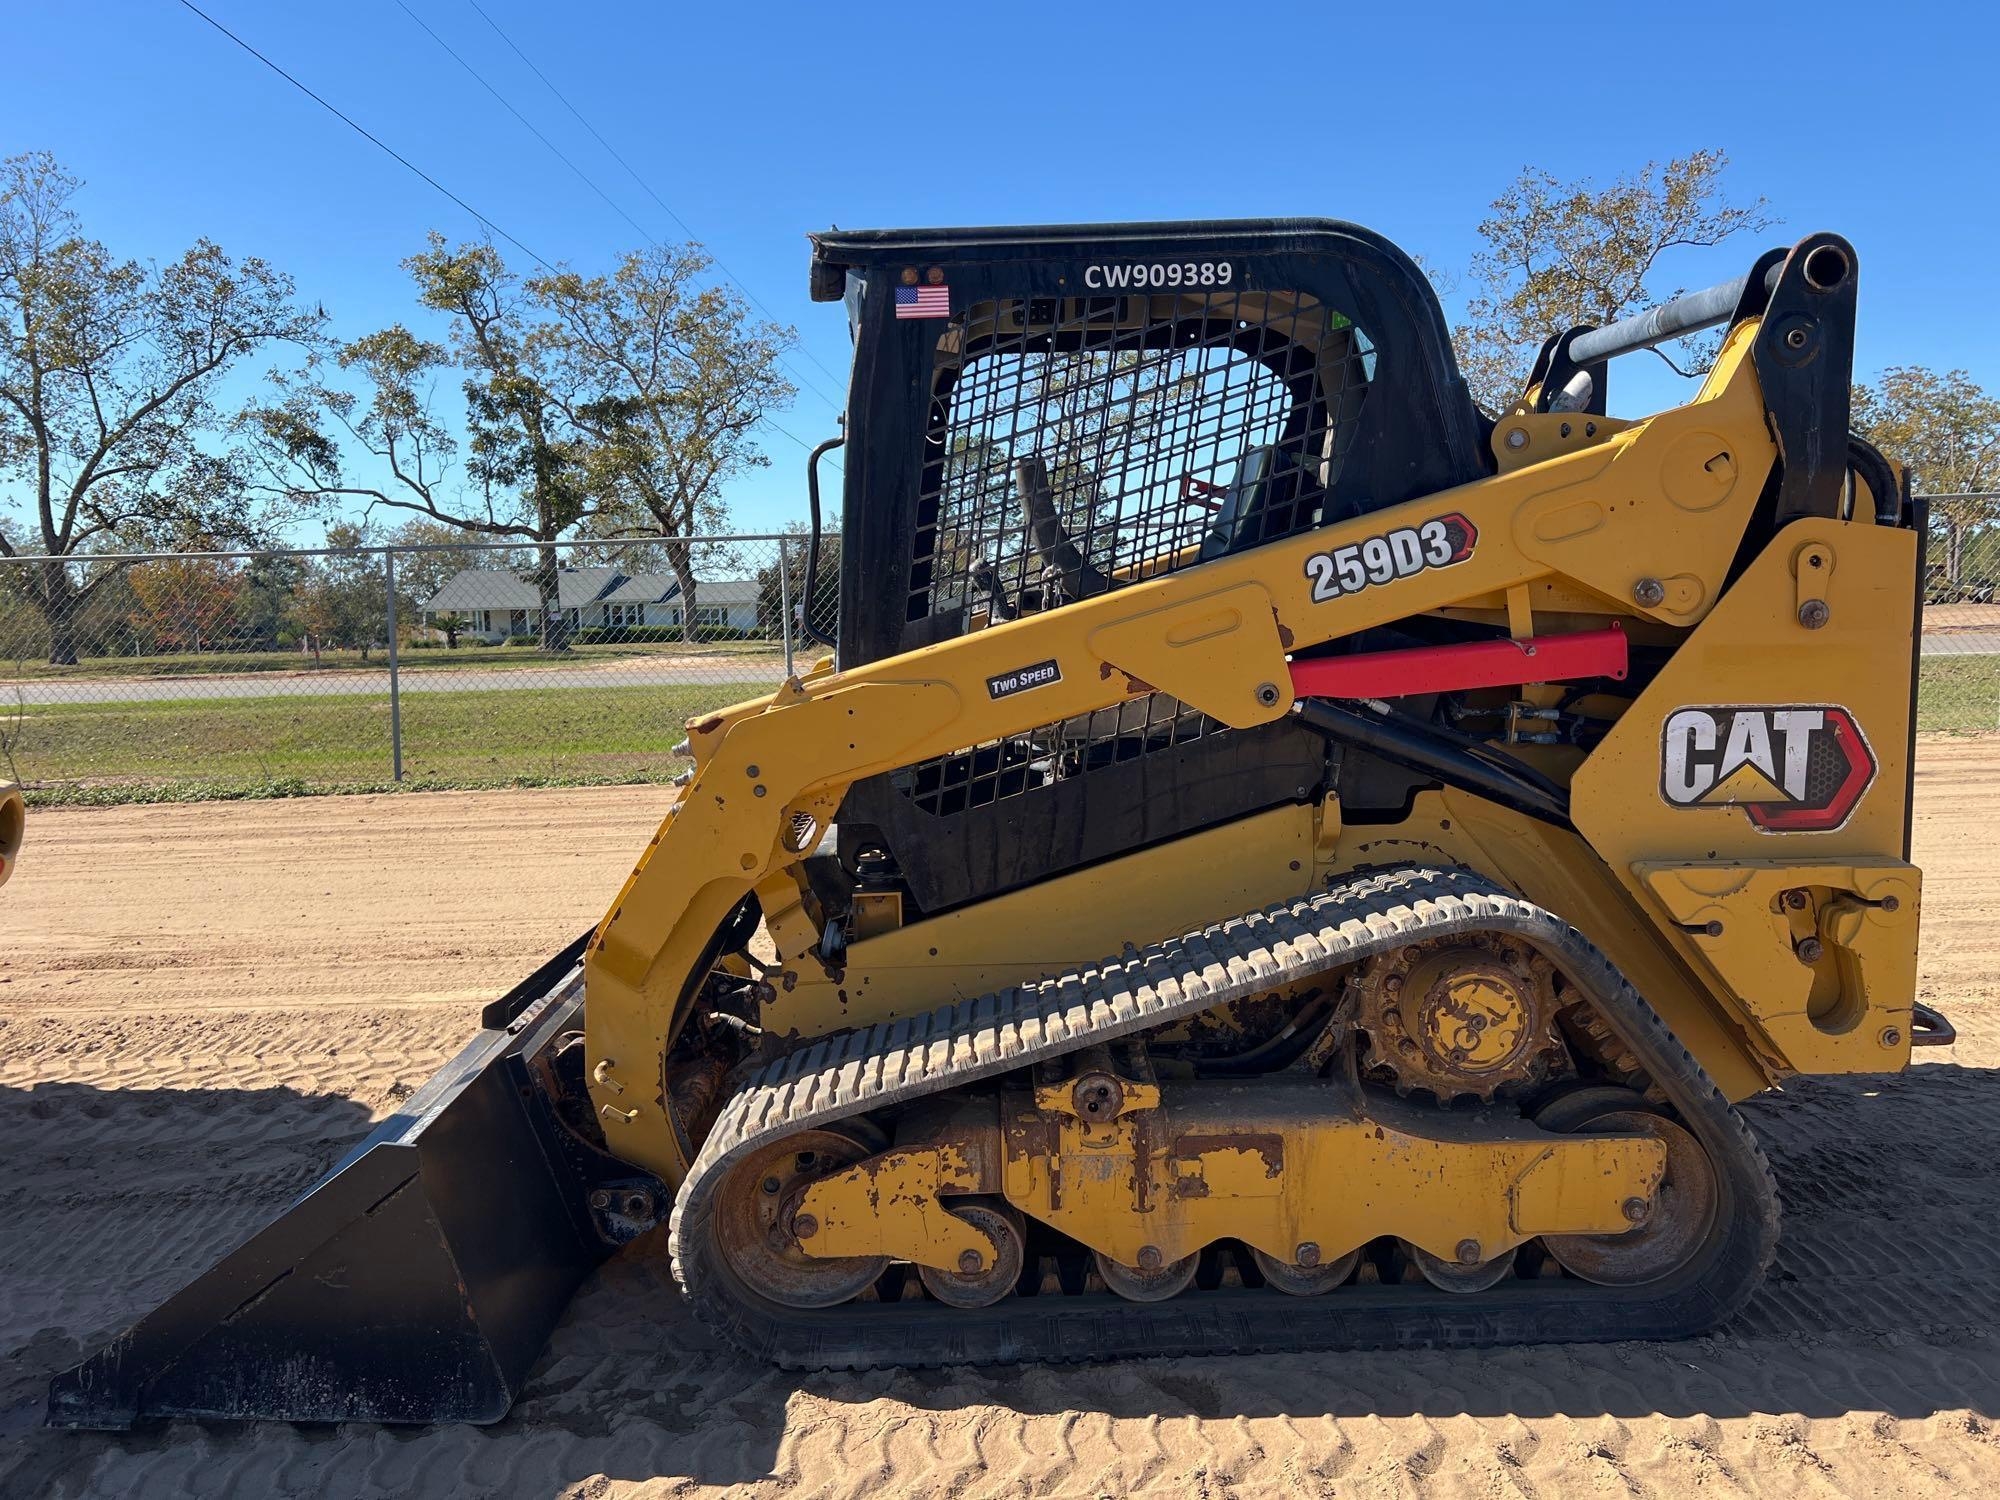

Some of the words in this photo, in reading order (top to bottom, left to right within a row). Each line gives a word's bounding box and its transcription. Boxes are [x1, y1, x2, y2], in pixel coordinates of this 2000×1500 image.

[1084, 262, 1232, 289] CW909389
[1306, 520, 1453, 602] 259D3
[1665, 710, 1824, 803] CAT
